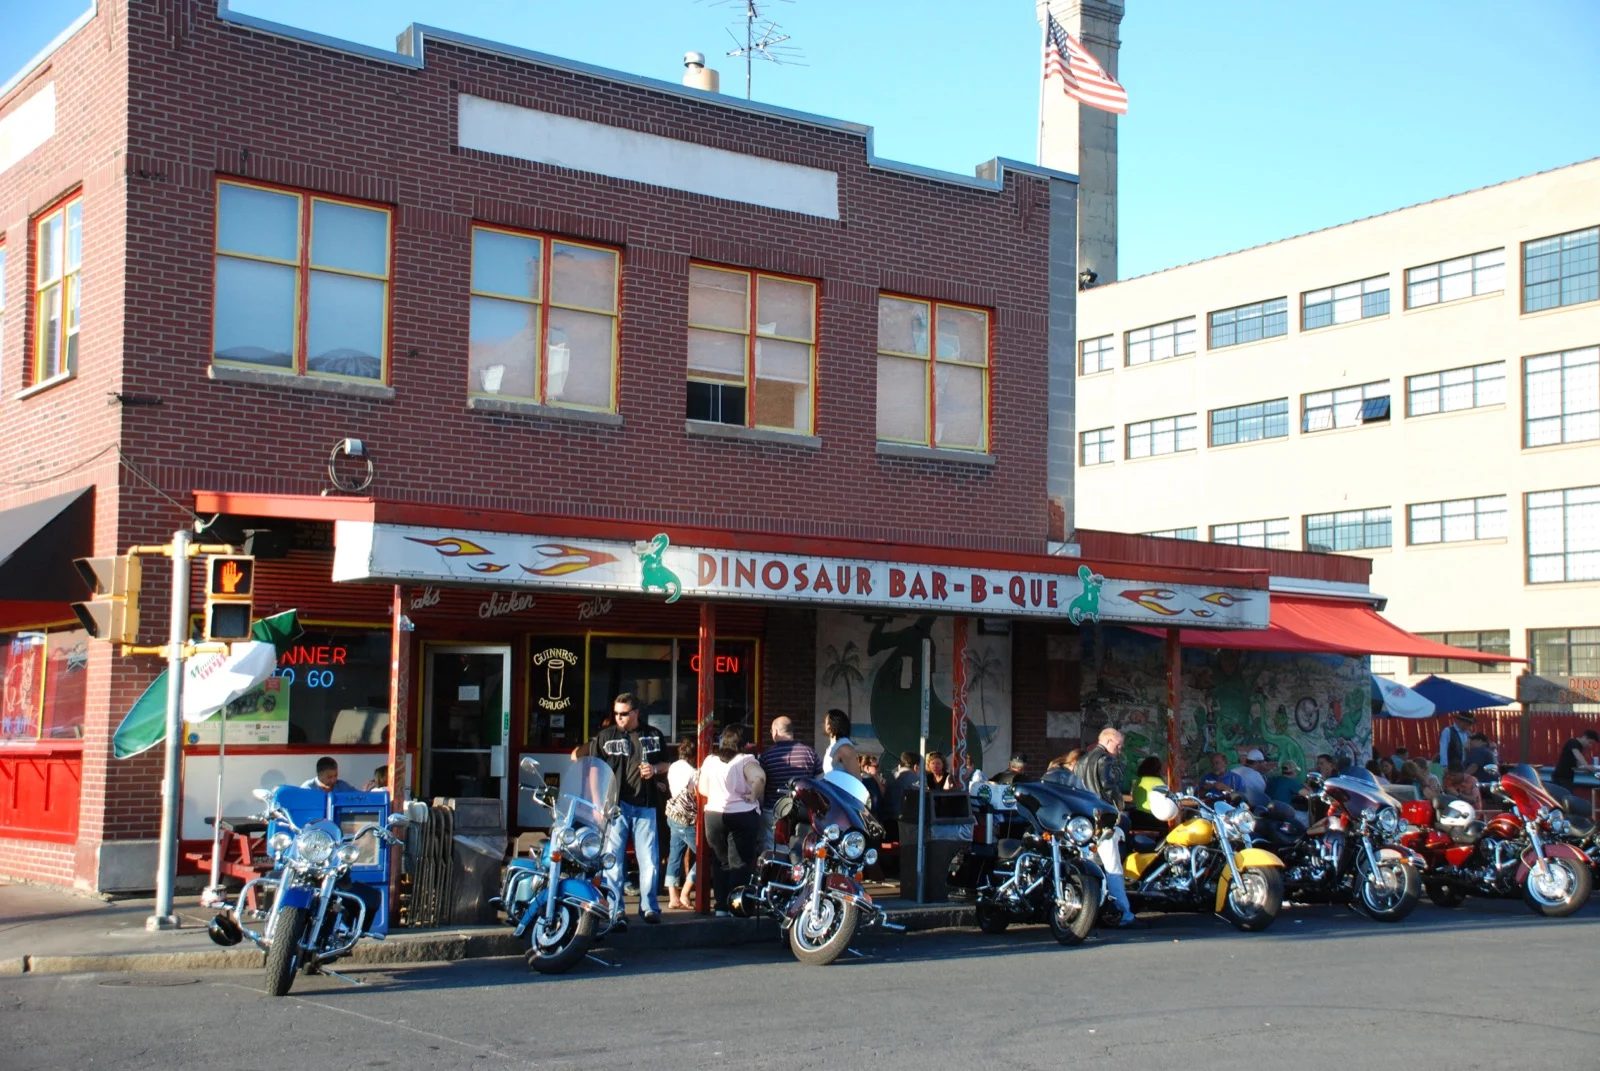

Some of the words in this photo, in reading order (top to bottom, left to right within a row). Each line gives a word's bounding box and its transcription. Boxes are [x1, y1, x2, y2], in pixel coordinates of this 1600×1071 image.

[698, 553, 873, 596] DINOSAUR
[888, 568, 1058, 608] BAR-B-QUE
[577, 596, 613, 621] Ribs
[276, 645, 347, 665] NNER
[533, 648, 578, 666] GUINNESS
[690, 655, 739, 673] OEN
[307, 669, 335, 688] GO
[538, 697, 571, 711] DRAUGHT
